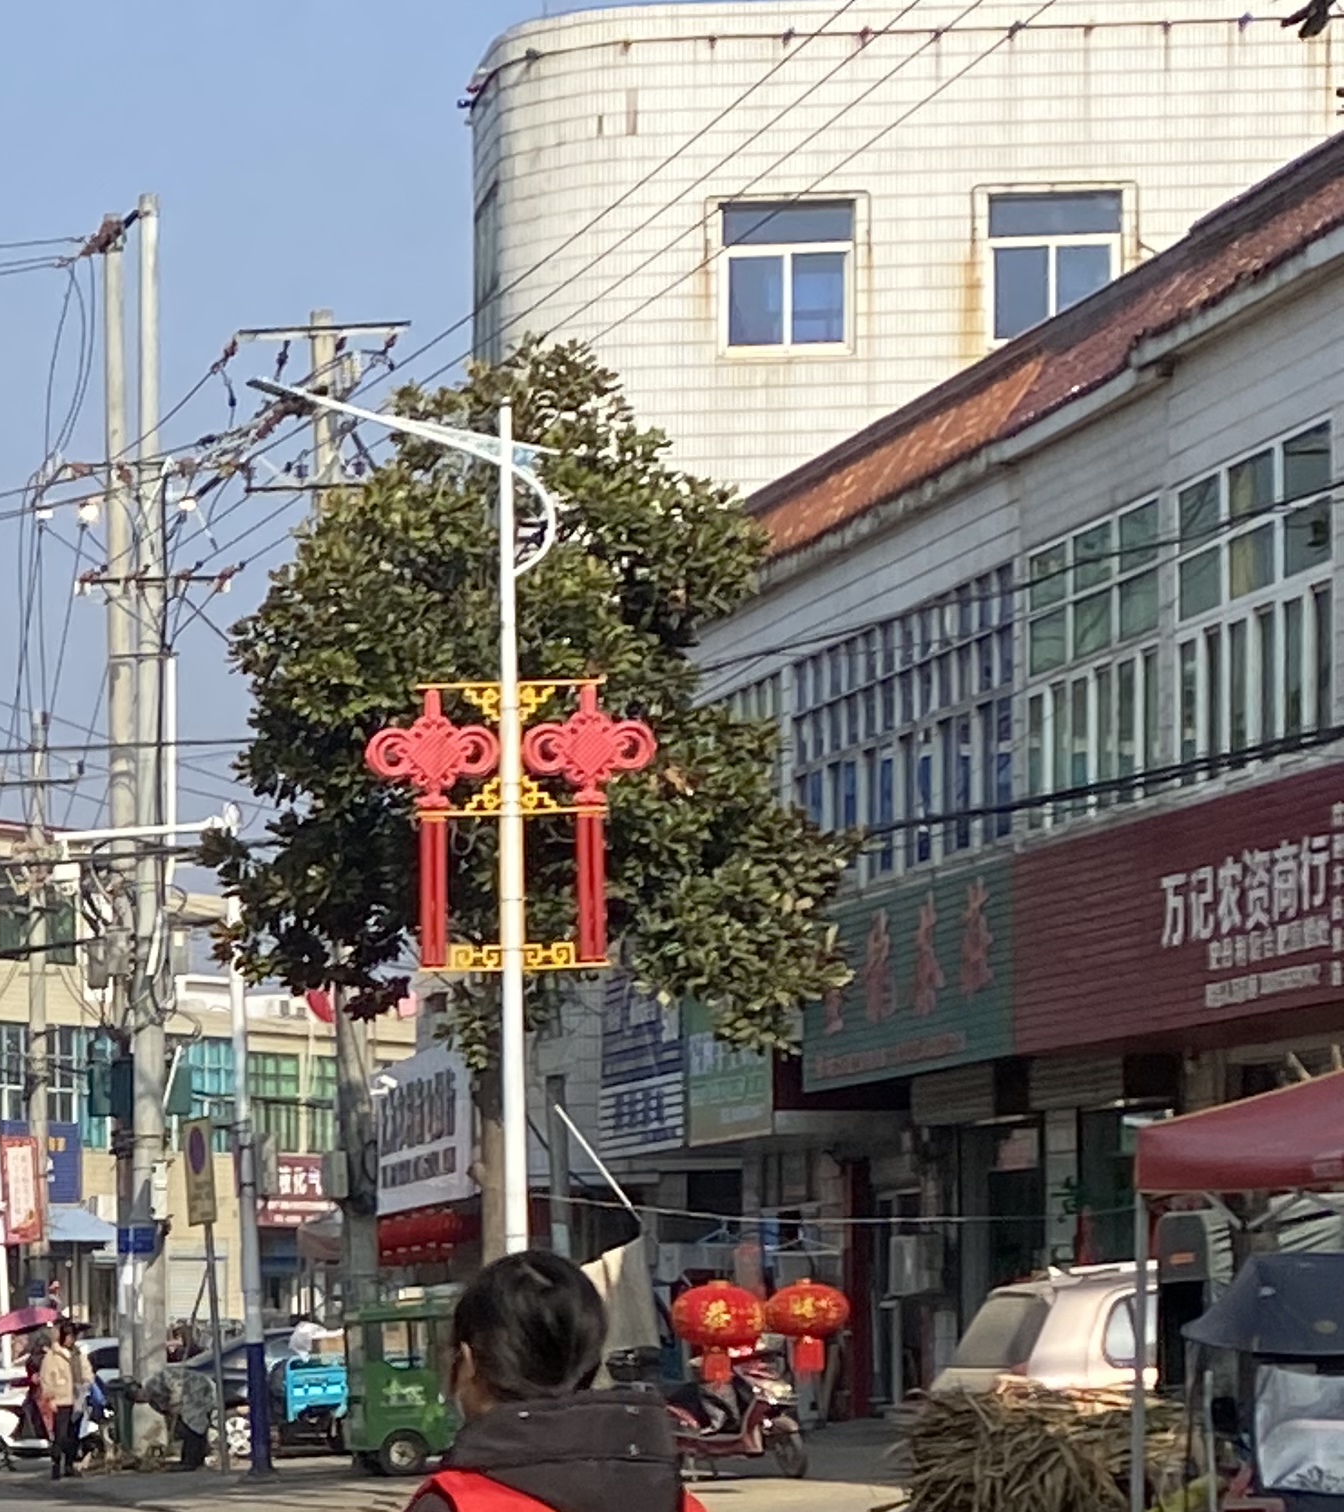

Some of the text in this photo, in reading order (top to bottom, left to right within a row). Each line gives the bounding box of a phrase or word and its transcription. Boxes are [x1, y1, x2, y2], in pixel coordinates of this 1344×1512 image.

[1161, 836, 1330, 948] 万记农资商行
